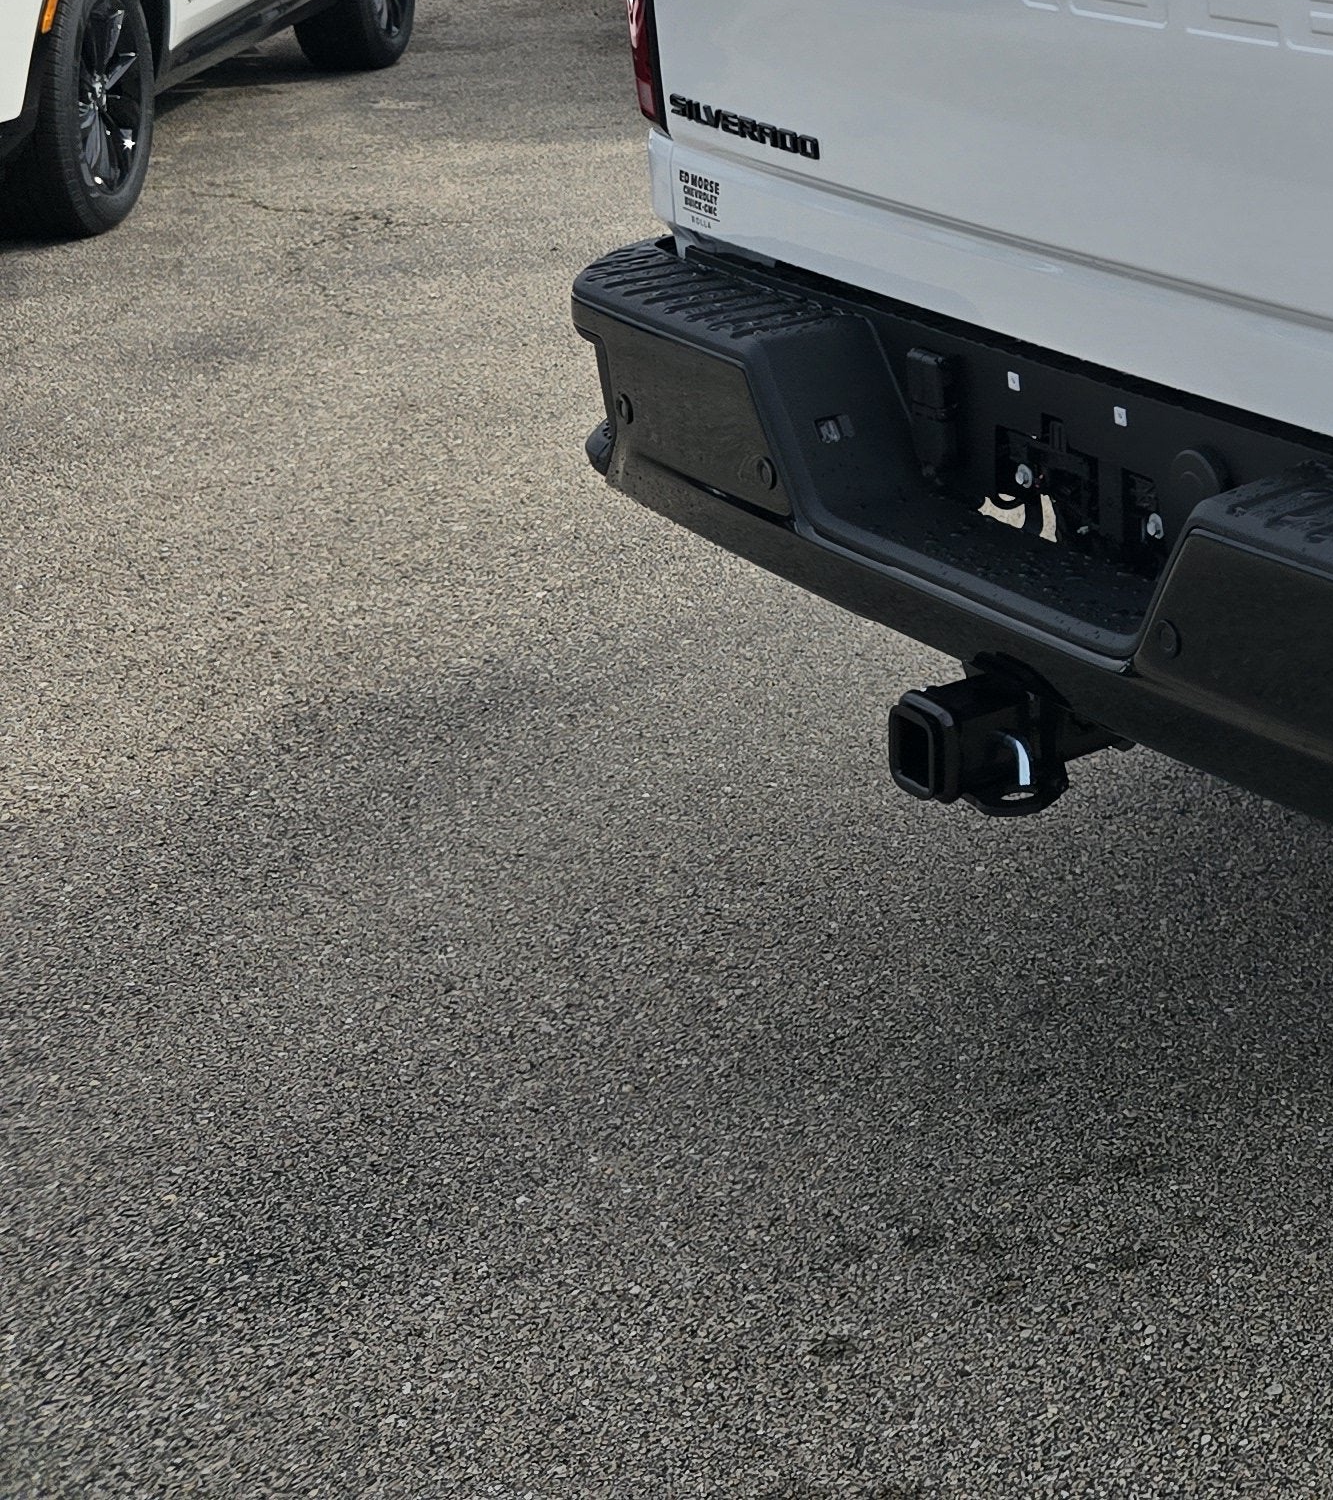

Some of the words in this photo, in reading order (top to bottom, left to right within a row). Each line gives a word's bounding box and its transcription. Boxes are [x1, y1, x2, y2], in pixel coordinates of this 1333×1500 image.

[669, 92, 821, 160] SILVERADO
[679, 169, 690, 184] ED
[690, 173, 720, 196] MORSE
[682, 184, 718, 206] CHEVROLET
